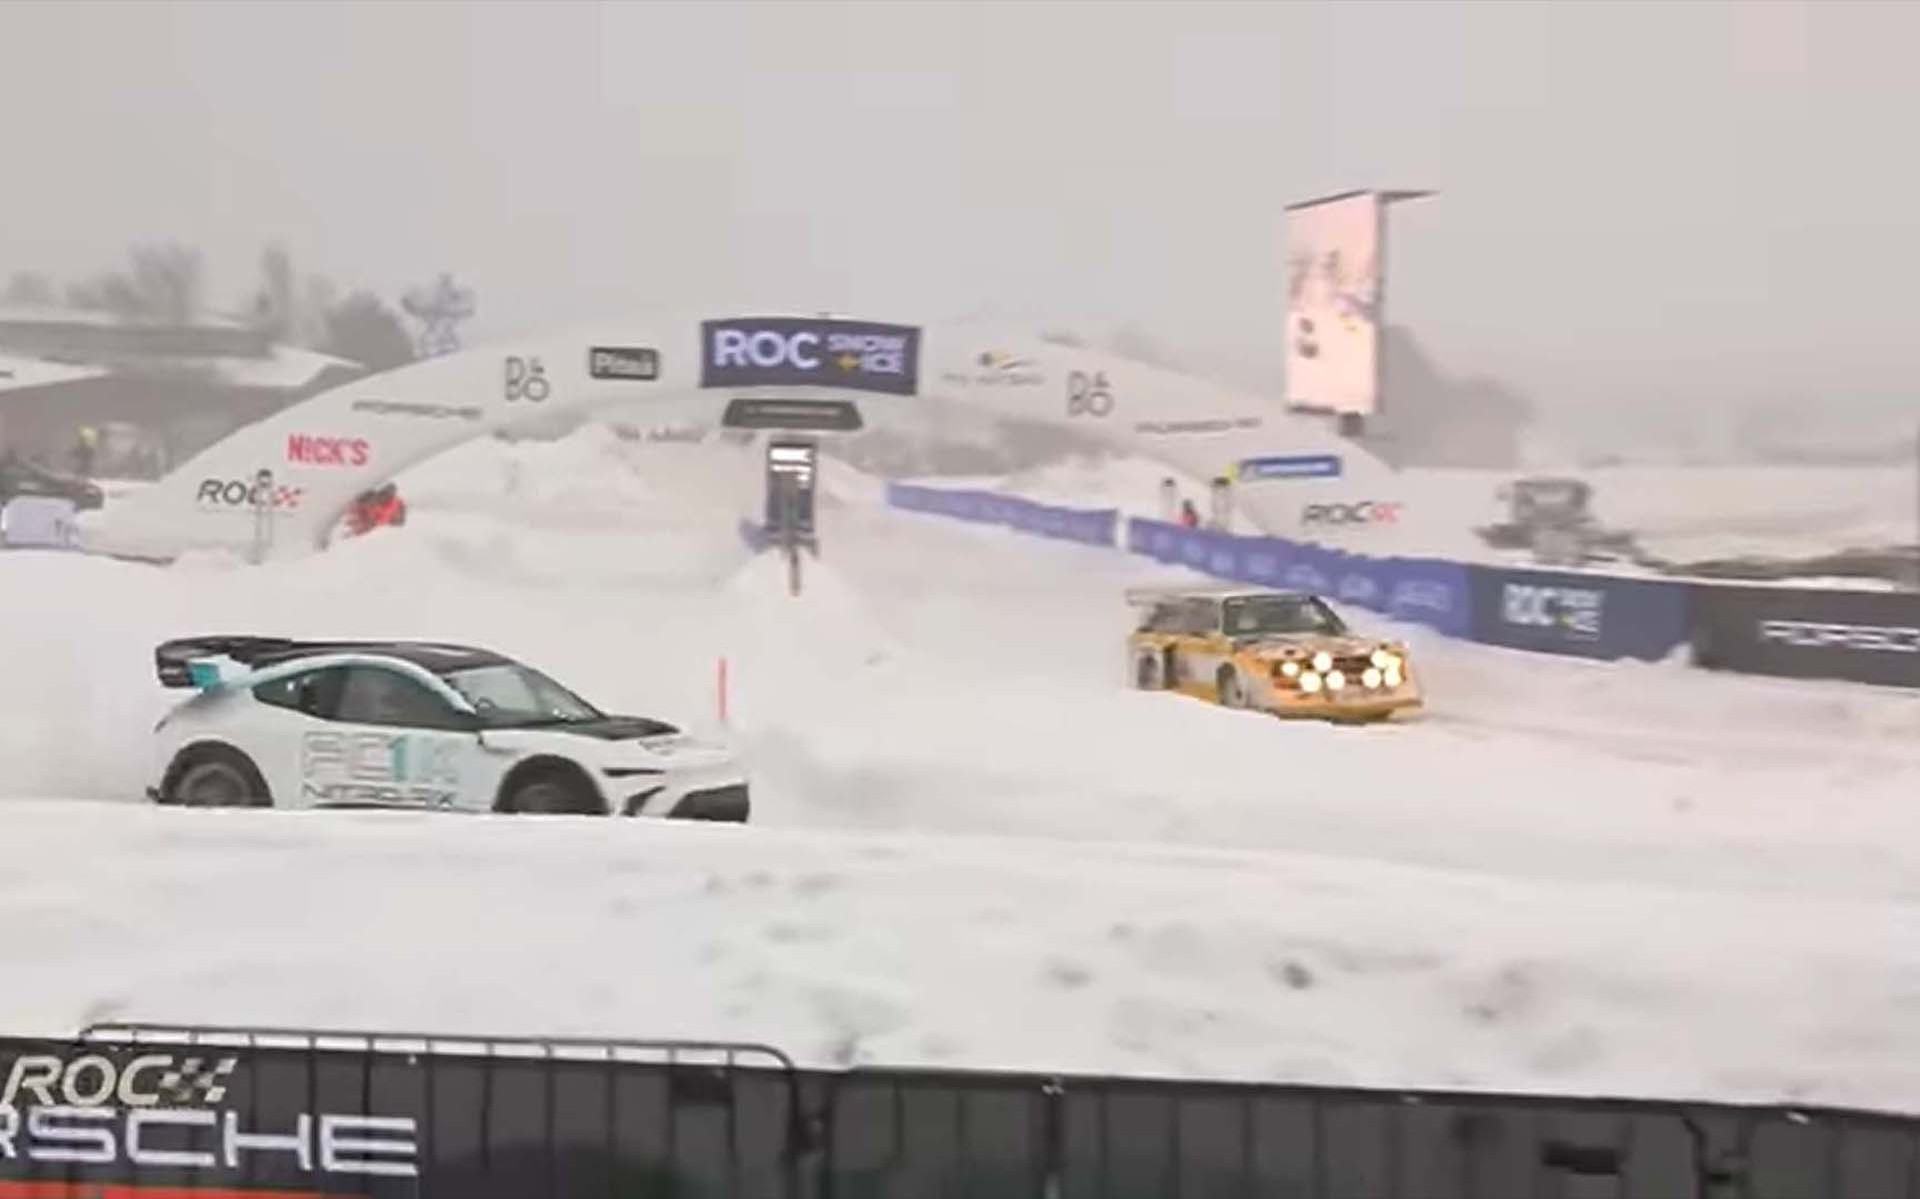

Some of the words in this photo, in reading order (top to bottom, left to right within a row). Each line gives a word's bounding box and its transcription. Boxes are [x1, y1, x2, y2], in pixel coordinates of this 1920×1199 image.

[713, 328, 820, 370] ROC
[826, 333, 905, 352] SNOW
[287, 433, 370, 467] NICK'S
[1302, 501, 1373, 525] ROC
[2, 1054, 174, 1107] ROC
[0, 1104, 419, 1177] SCHE
